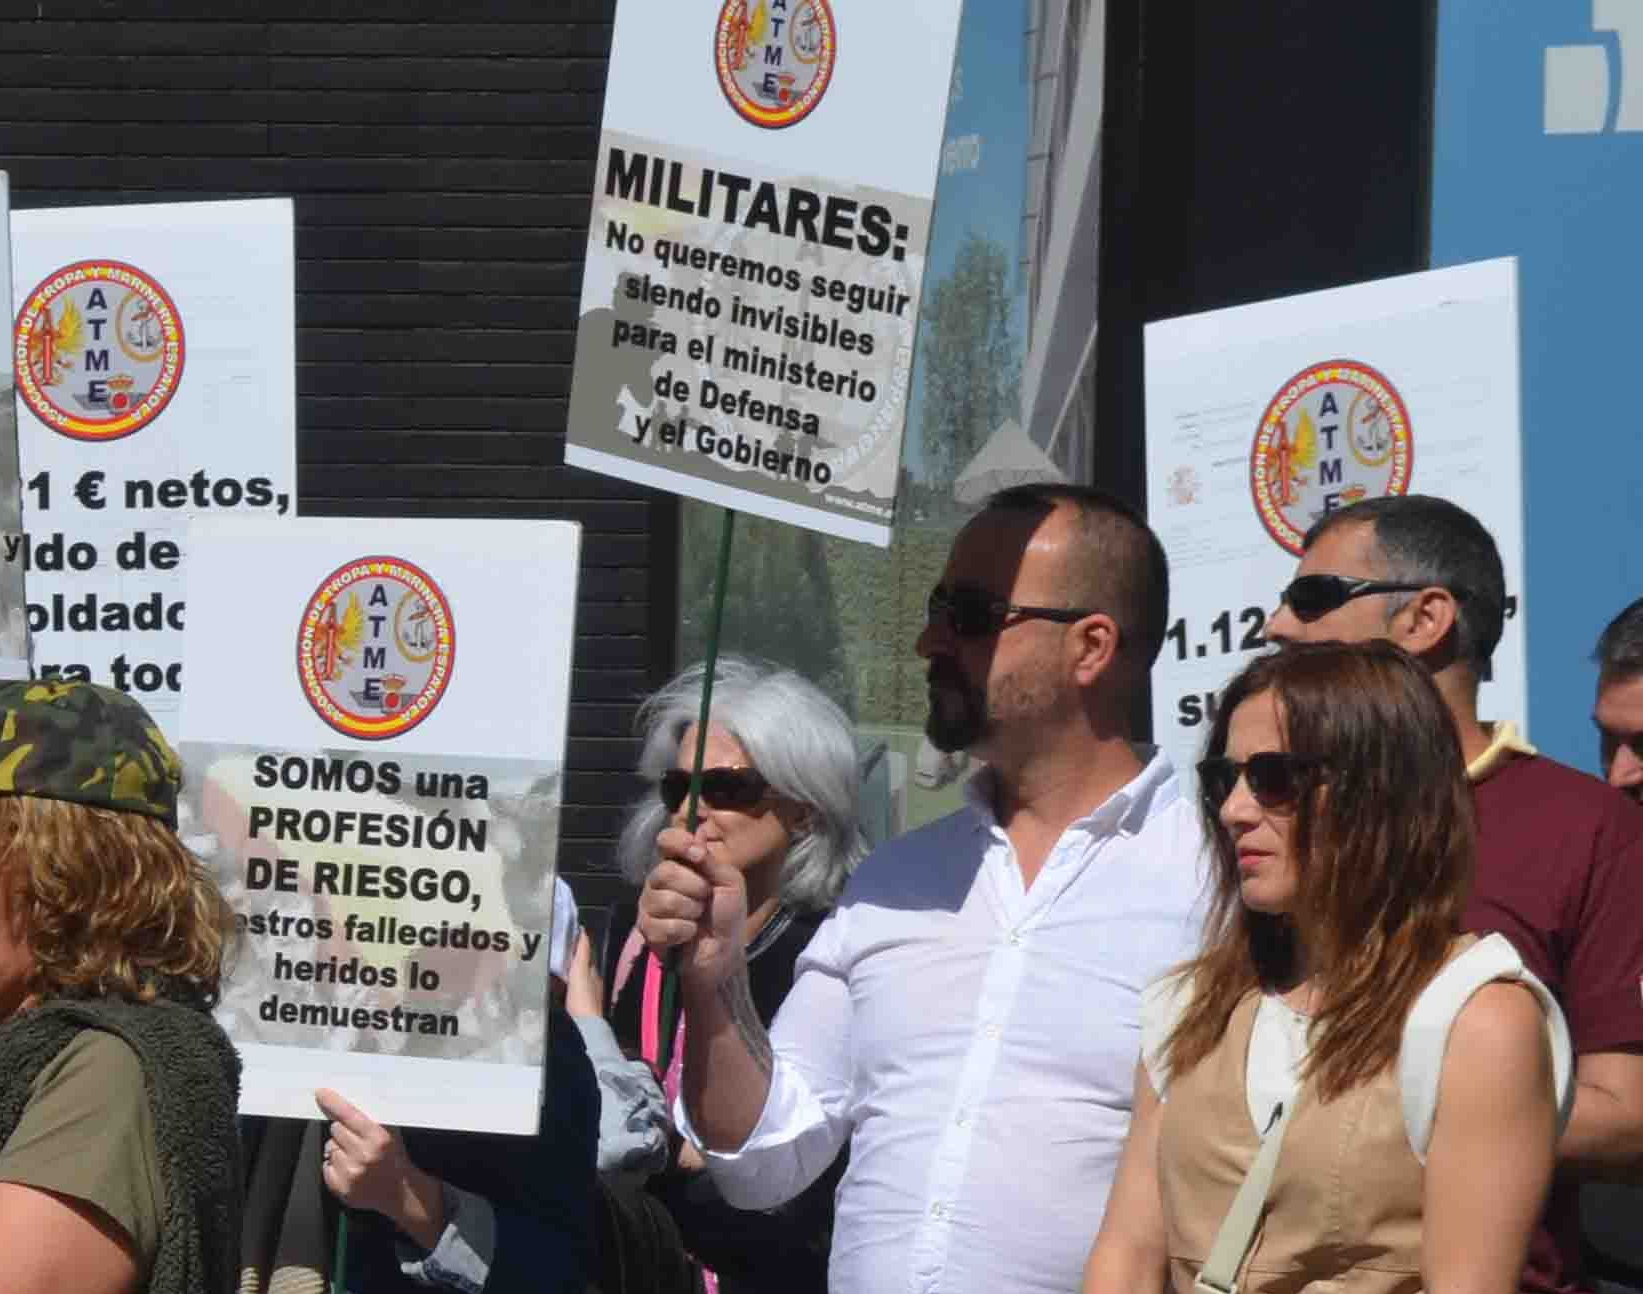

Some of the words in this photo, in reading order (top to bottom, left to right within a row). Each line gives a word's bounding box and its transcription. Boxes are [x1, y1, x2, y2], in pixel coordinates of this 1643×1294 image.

[604, 147, 910, 262] MILITARES:
[606, 220, 644, 255] No
[654, 240, 801, 292] queremos
[810, 273, 910, 318] seguir
[624, 273, 722, 318] siendo
[730, 296, 875, 355] invisibles
[84, 287, 110, 403] ATME
[612, 318, 678, 355] para
[687, 334, 713, 363] el
[722, 342, 877, 402] ministerio
[653, 369, 691, 402] de
[699, 380, 820, 436] Defensa
[634, 415, 651, 444] y
[659, 417, 685, 448] el
[696, 423, 832, 484] Gobierno
[27, 471, 51, 510] 1
[73, 470, 107, 510] €
[124, 471, 291, 516] netos,
[3, 535, 23, 562] y
[23, 533, 98, 571] ldo
[116, 532, 180, 571] de
[363, 584, 387, 701] ATME
[253, 755, 402, 797] SOMOS
[416, 769, 489, 800] una
[248, 804, 487, 853] PROFESIÓN
[246, 857, 298, 891] DE
[313, 861, 482, 912] RIESGO,
[344, 913, 513, 953] fallecidos
[521, 932, 542, 962] y
[274, 952, 398, 991] heridos
[409, 960, 440, 991] lo
[259, 994, 459, 1038] demuestran
